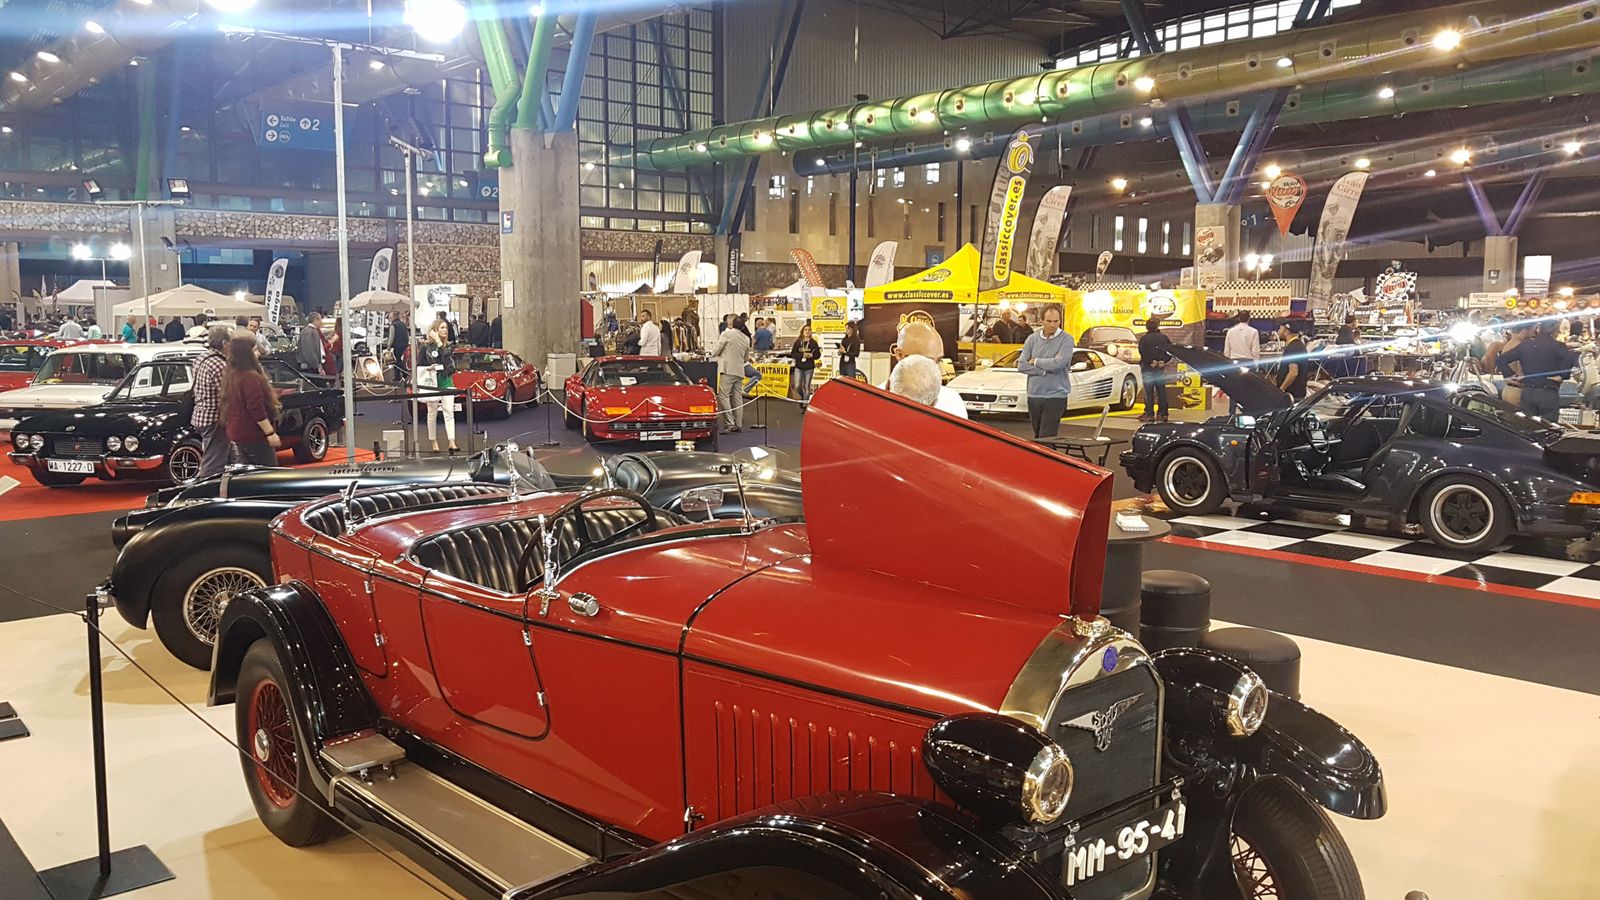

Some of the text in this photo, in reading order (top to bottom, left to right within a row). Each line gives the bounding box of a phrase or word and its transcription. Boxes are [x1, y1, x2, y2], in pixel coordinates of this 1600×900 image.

[312, 119, 320, 131] 2
[67, 187, 77, 200] 2
[491, 187, 499, 198] 2
[996, 179, 1023, 277] classiccover.es
[887, 291, 949, 299] www.classiccover.es
[1215, 293, 1289, 306] www.ivancirre.com
[1067, 803, 1186, 886] MM-95-41
